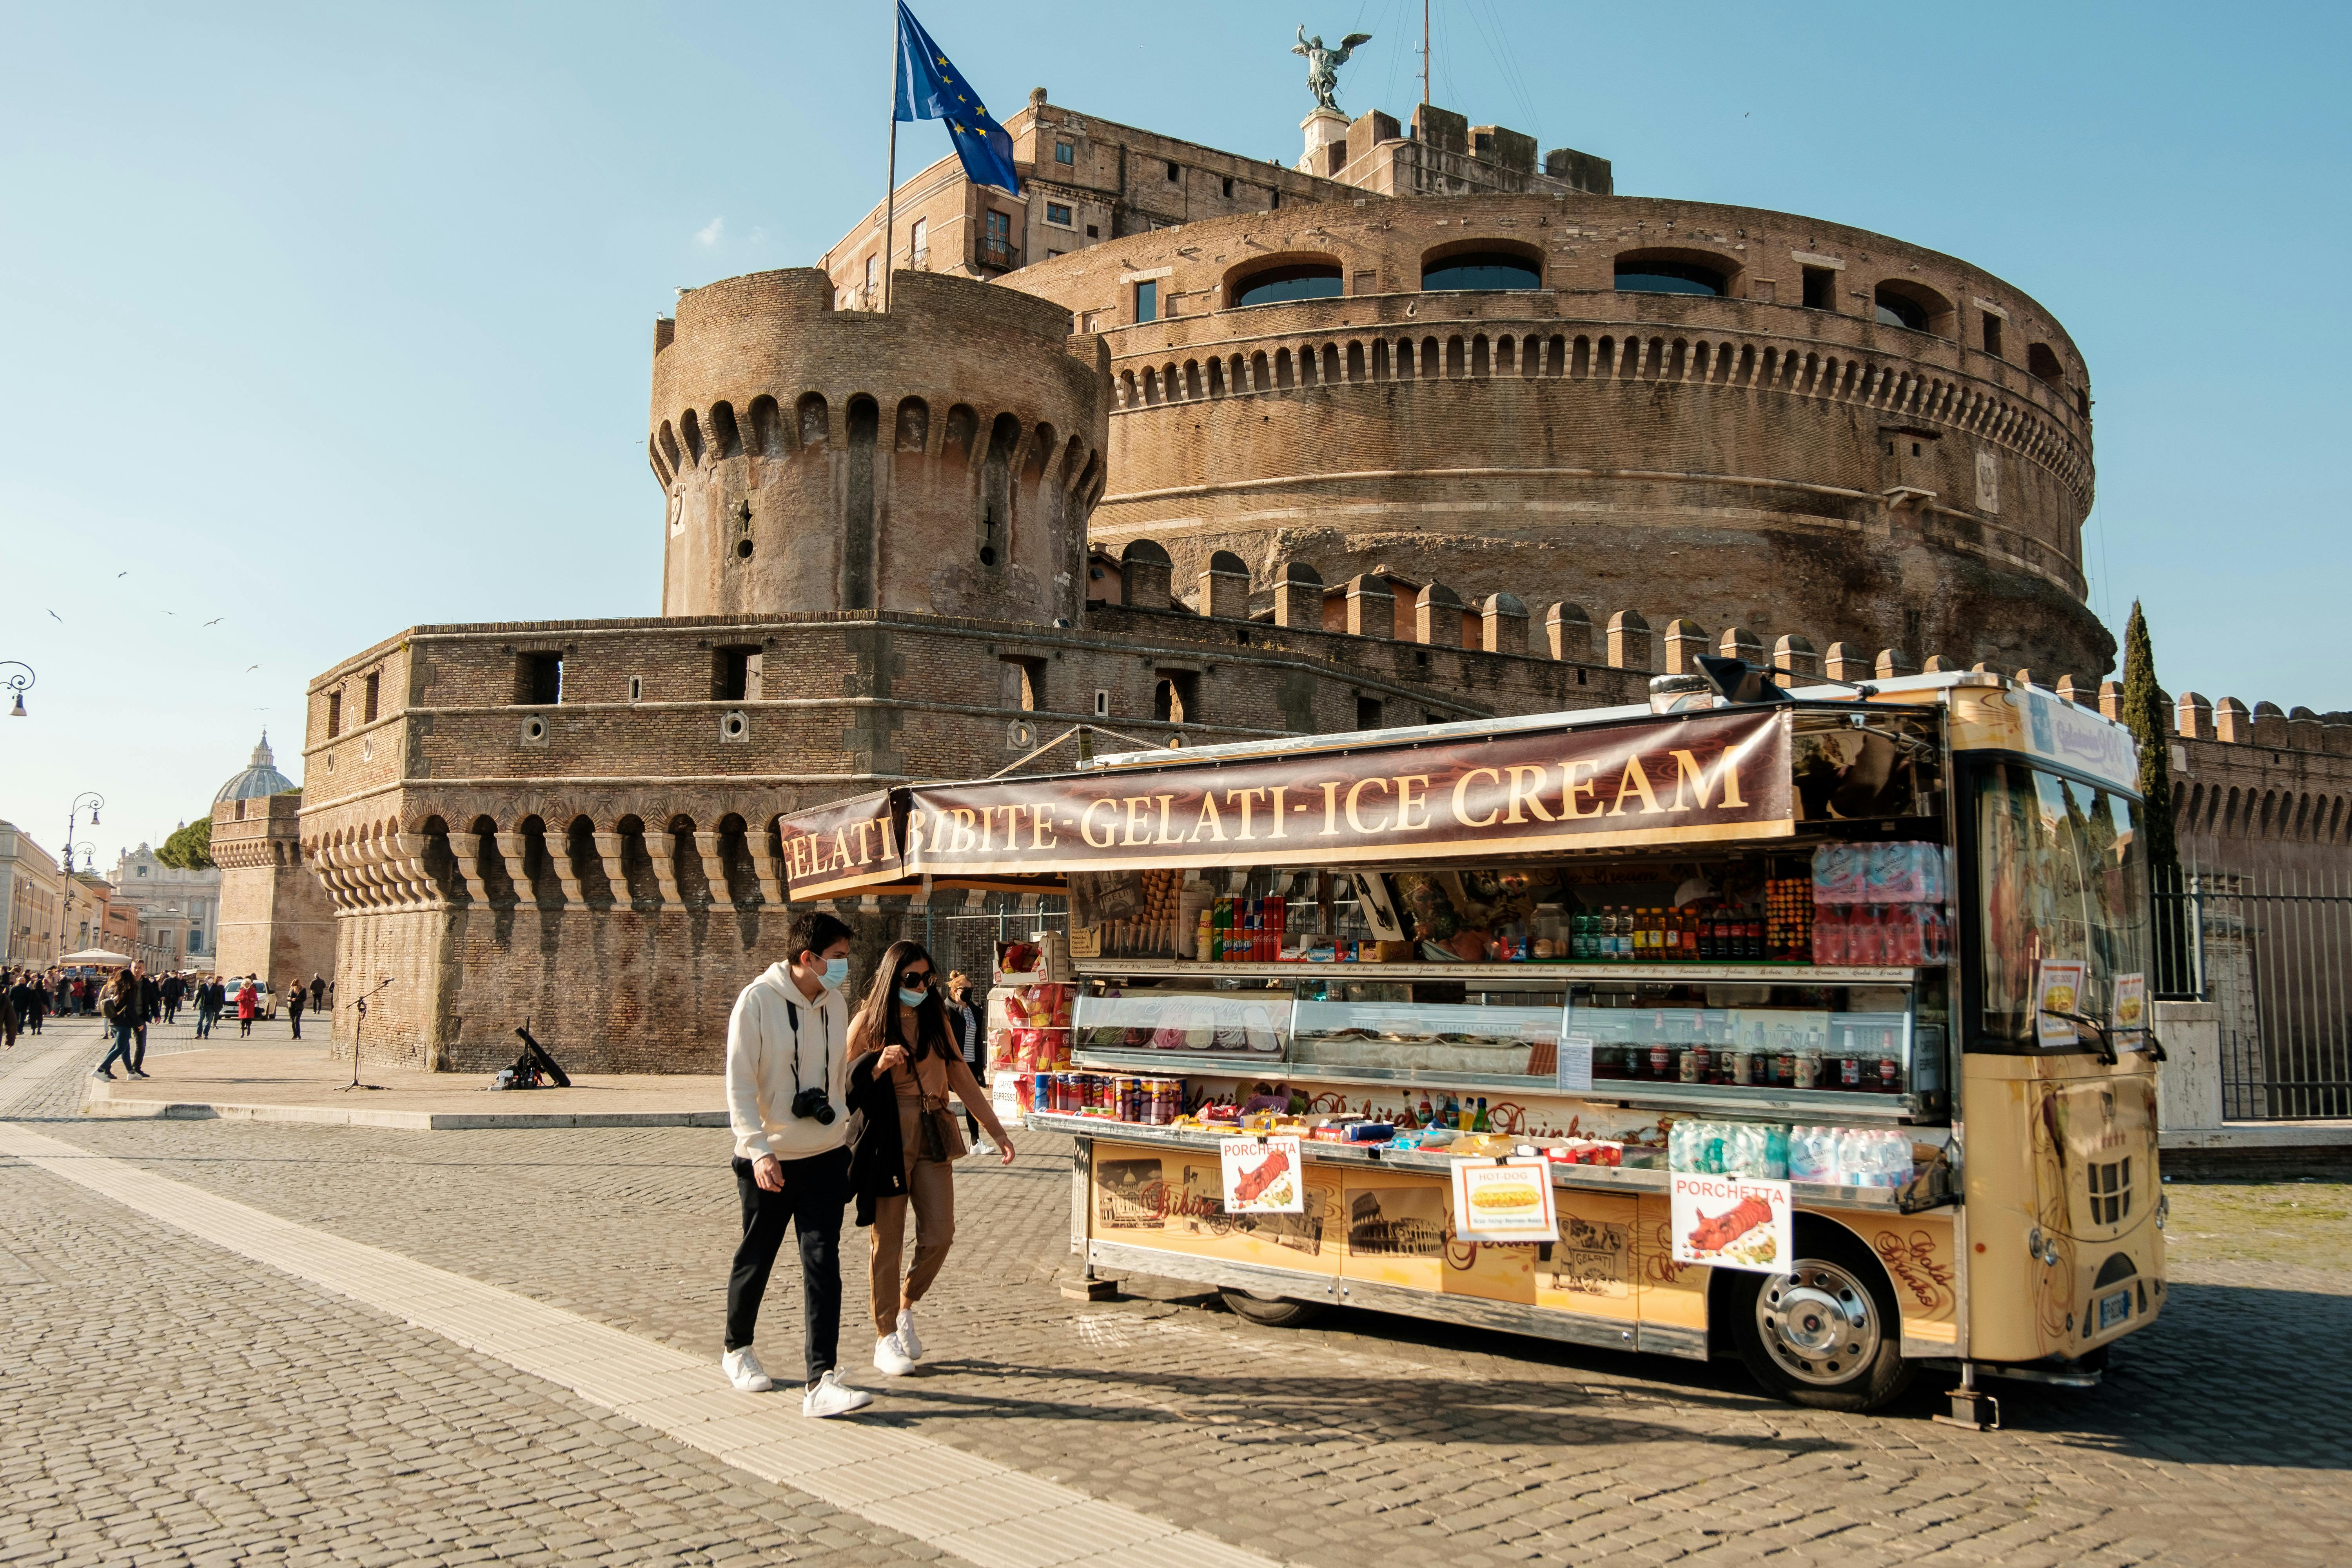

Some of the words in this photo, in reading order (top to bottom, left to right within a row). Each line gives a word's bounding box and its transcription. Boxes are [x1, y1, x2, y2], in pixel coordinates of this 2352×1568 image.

[1451, 745, 1749, 827] CREAM
[1486, 965, 1508, 973] Cream
[1515, 964, 1532, 973] Cold
[1673, 965, 1712, 974] Sandwich
[1810, 966, 1839, 976] Cream
[1848, 966, 1870, 976] Cold
[1145, 997, 1215, 1015] Gelateria
[1744, 1031, 1785, 1046] COONA
[1791, 1032, 1825, 1047] ISLAD
[994, 1092, 1016, 1102] ESPRESSO
[1185, 1084, 1235, 1110] elati
[1224, 1142, 1296, 1156] PORCHETTA
[1479, 1172, 1528, 1181] HOT-DOG
[1141, 1181, 1217, 1219] Bibite
[1676, 1179, 1784, 1204] PORCHETTA
